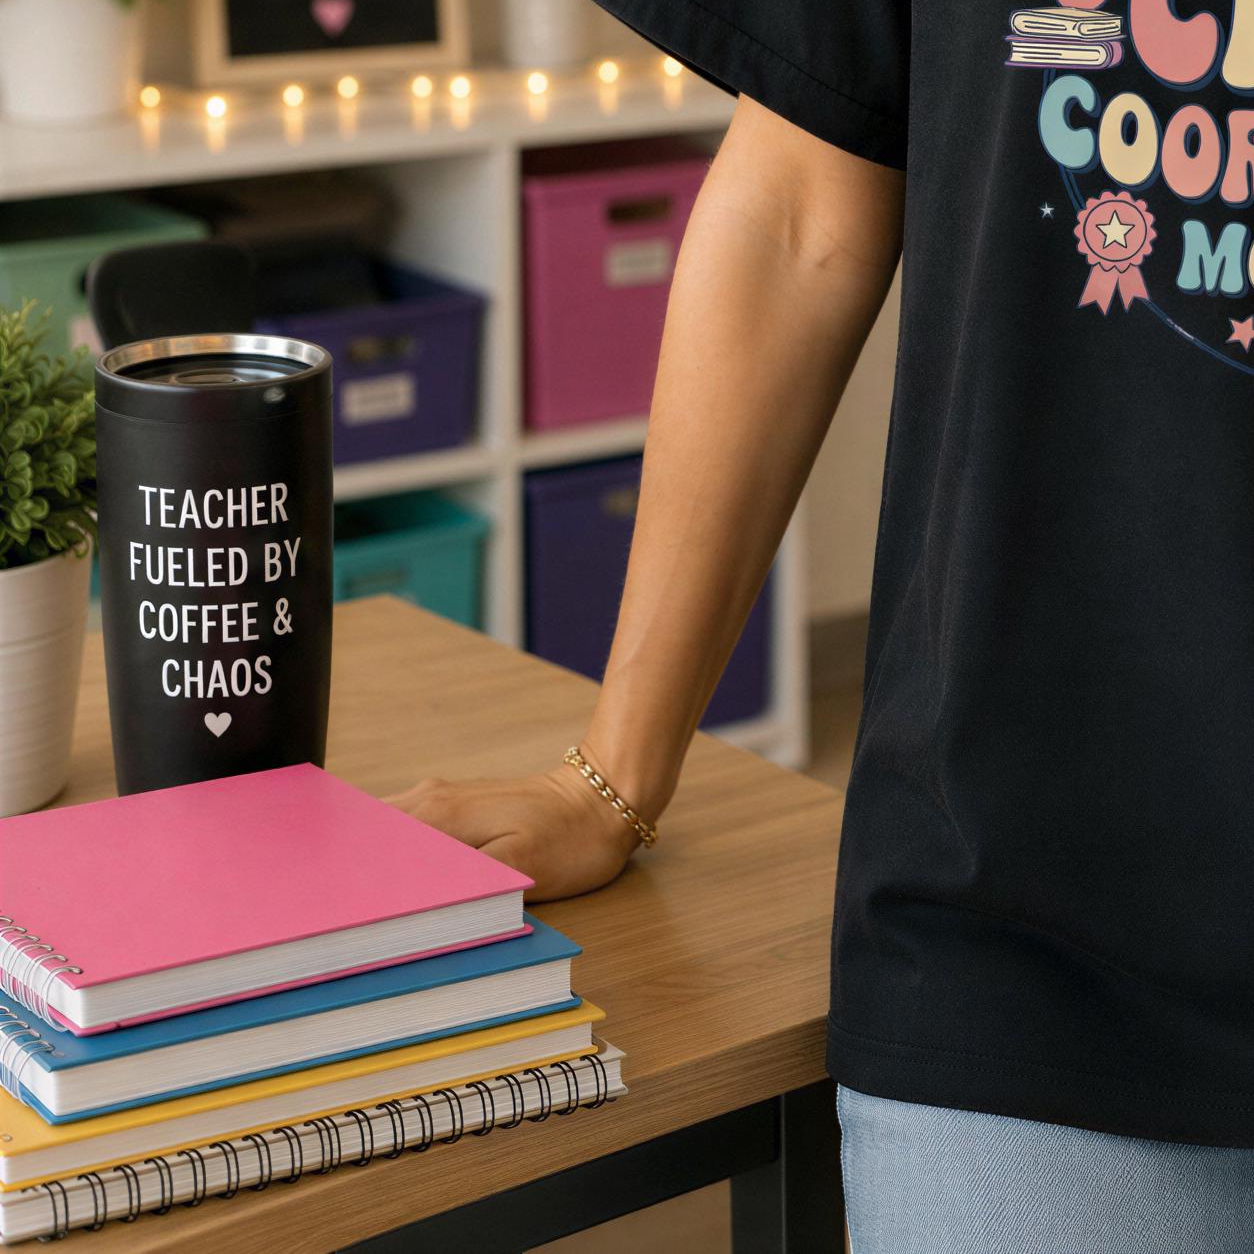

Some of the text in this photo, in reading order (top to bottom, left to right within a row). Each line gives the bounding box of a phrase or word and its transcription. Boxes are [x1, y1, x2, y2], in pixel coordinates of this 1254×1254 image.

[138, 482, 289, 530] TEACHER
[129, 537, 301, 587] FUELED BY
[138, 597, 294, 644] COFFEE &
[161, 655, 273, 699] CHAOS
